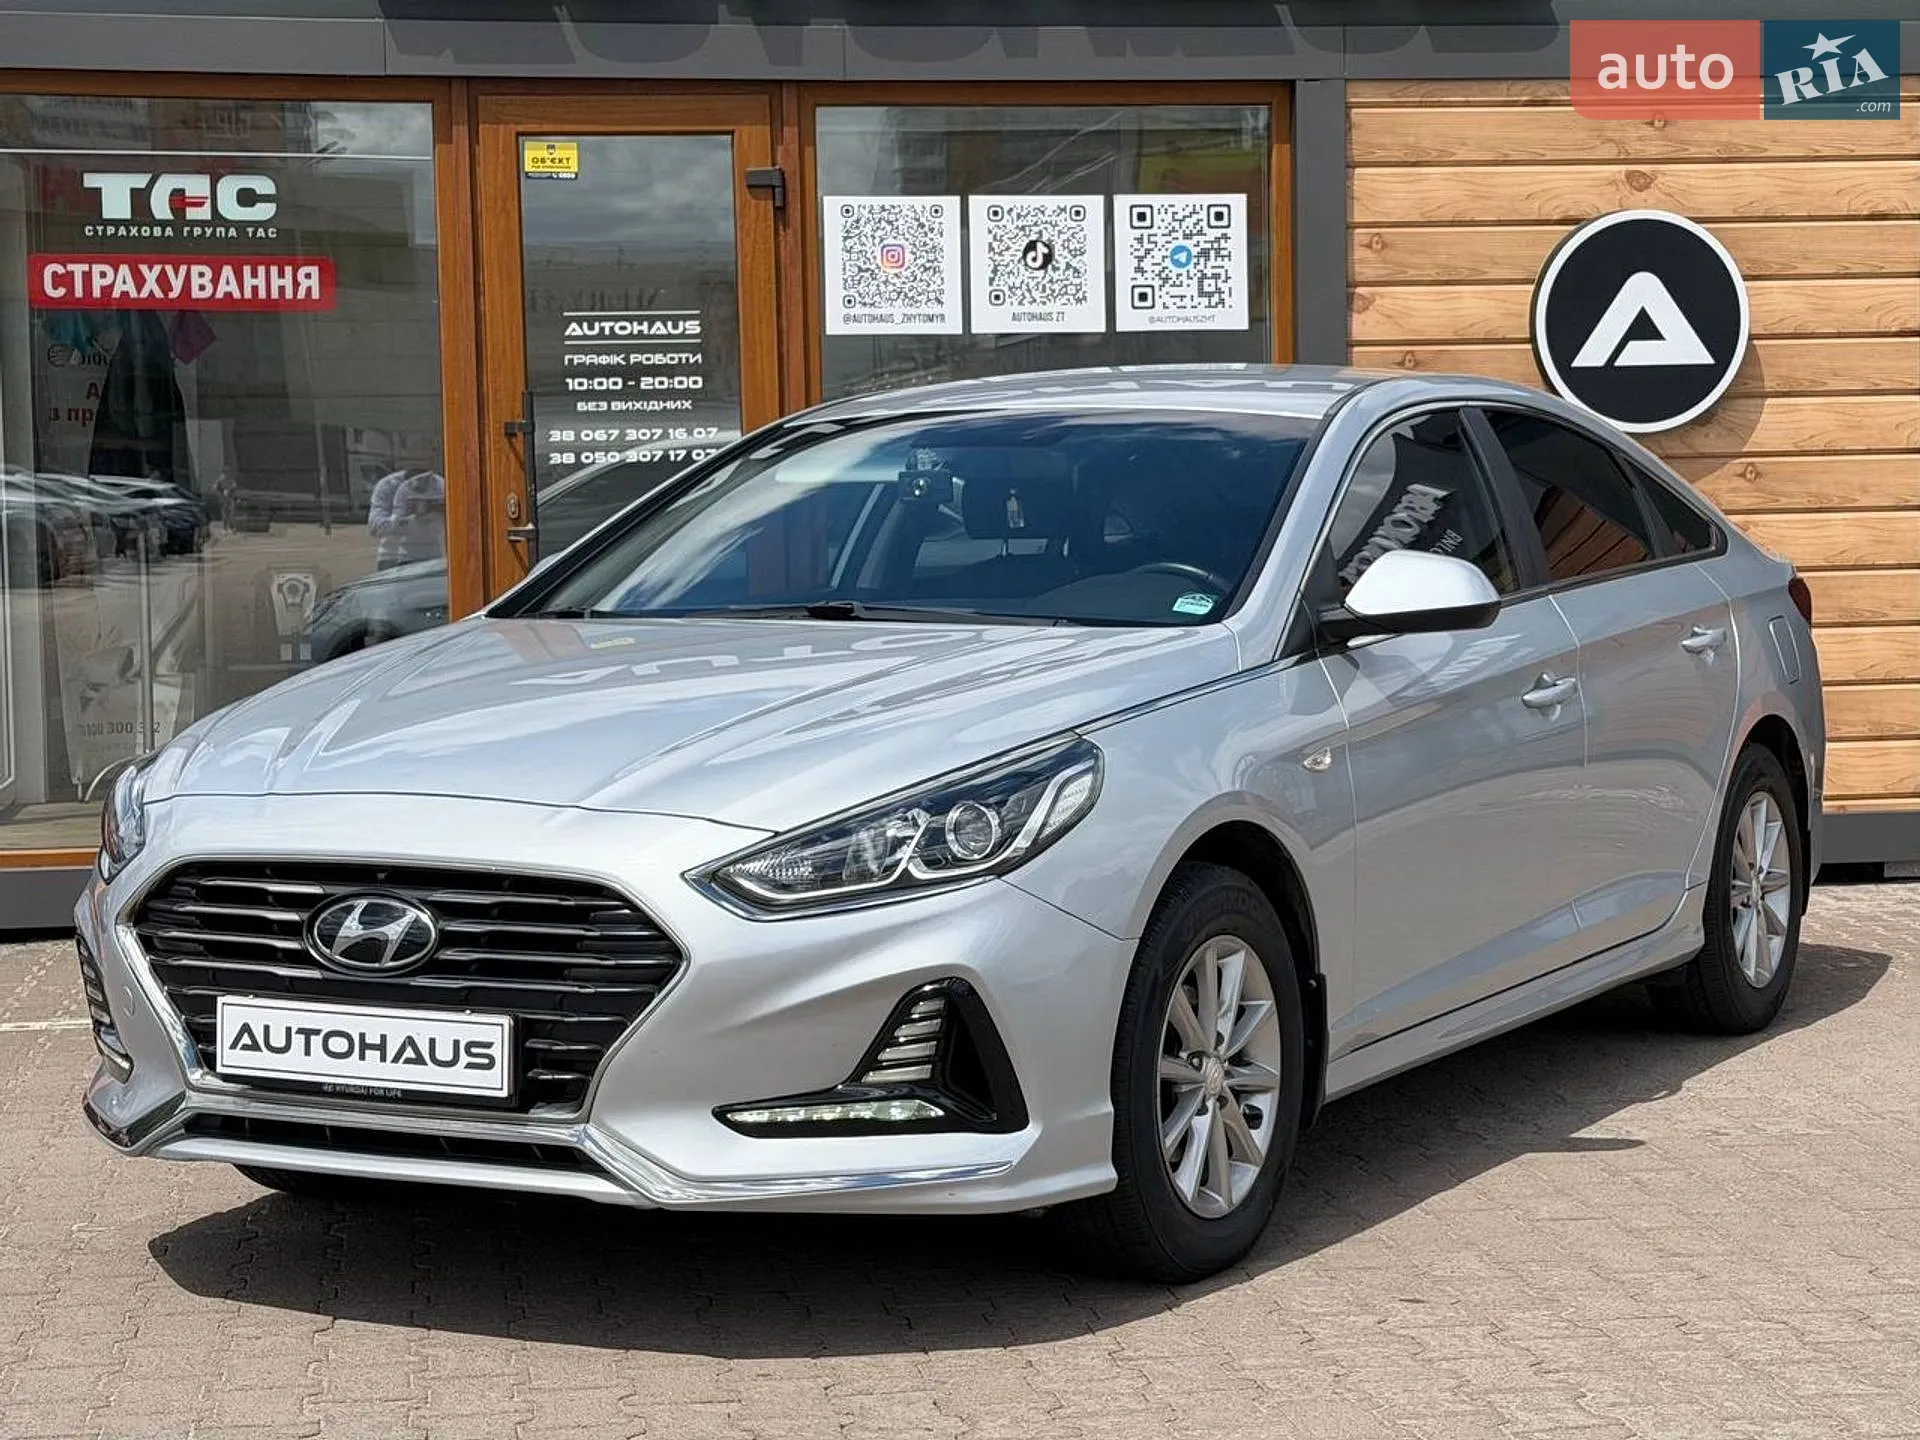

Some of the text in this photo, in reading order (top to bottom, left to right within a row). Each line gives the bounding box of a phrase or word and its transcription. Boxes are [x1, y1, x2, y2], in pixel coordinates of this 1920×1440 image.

[83, 172, 278, 221] ТАС
[84, 225, 278, 238] СТРАХОВА ГРУПА ТАС
[43, 263, 321, 300] СТРАХУВАННЯ
[1011, 312, 1054, 322] AUTOHAUS
[564, 320, 702, 336] AUTOHAUS
[564, 352, 703, 366] ГРАФІК РОБОТИ
[565, 377, 623, 391] 10:00
[640, 376, 704, 390] 20:00
[576, 400, 692, 412] БЕЗ ВИХІДНИХ
[548, 430, 576, 442] 38
[580, 429, 620, 442] 067
[625, 428, 663, 441] 307
[548, 452, 576, 465] 38
[580, 451, 620, 464] 050
[625, 450, 664, 463] 307
[668, 449, 687, 462] 17
[229, 1022, 496, 1071] AUTOHAUS
